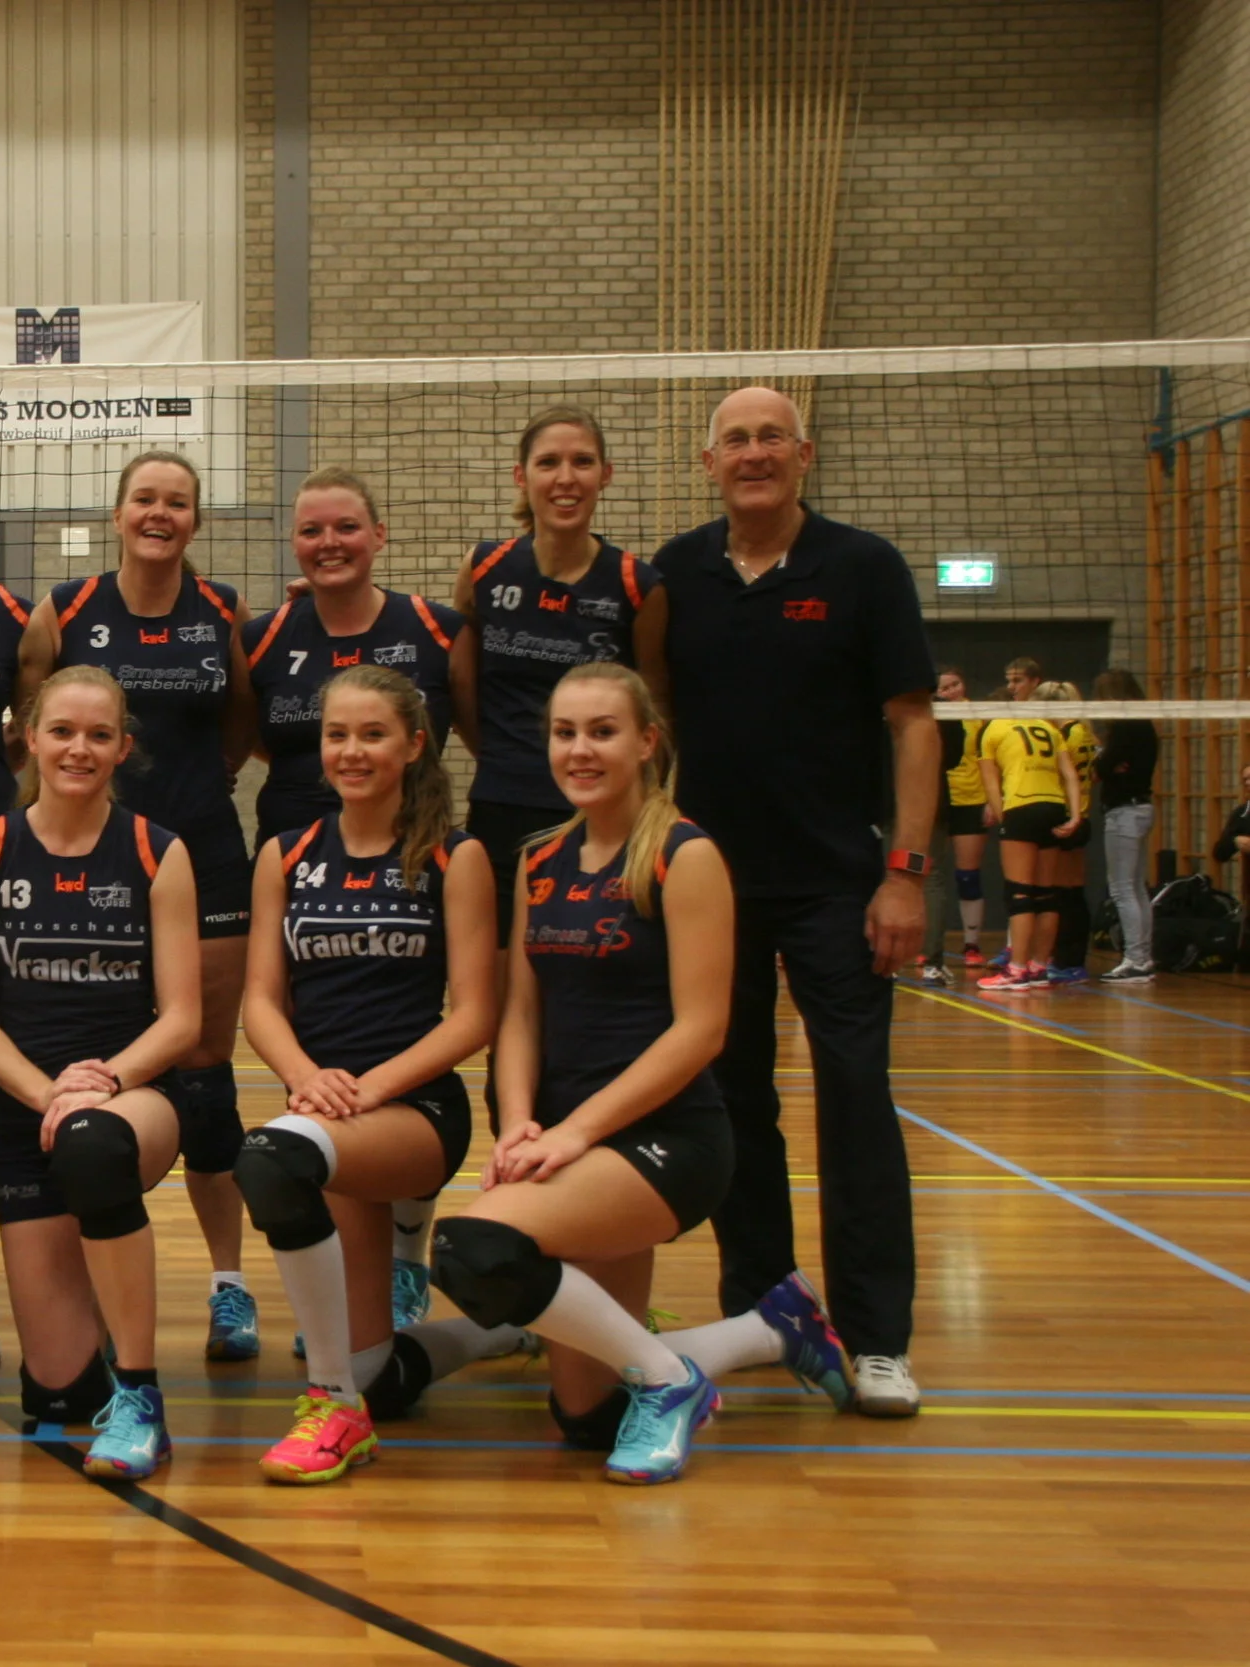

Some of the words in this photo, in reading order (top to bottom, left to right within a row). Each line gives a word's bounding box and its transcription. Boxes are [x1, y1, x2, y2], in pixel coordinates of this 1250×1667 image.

[17, 398, 154, 421] MOONEN
[490, 584, 522, 611] 10
[90, 624, 110, 648] 3
[288, 651, 308, 675] 7
[116, 678, 211, 694] dersbedrijf
[1012, 726, 1054, 758] 19
[295, 861, 328, 889] 24
[0, 879, 32, 909] 13
[284, 916, 427, 962] Vrancken
